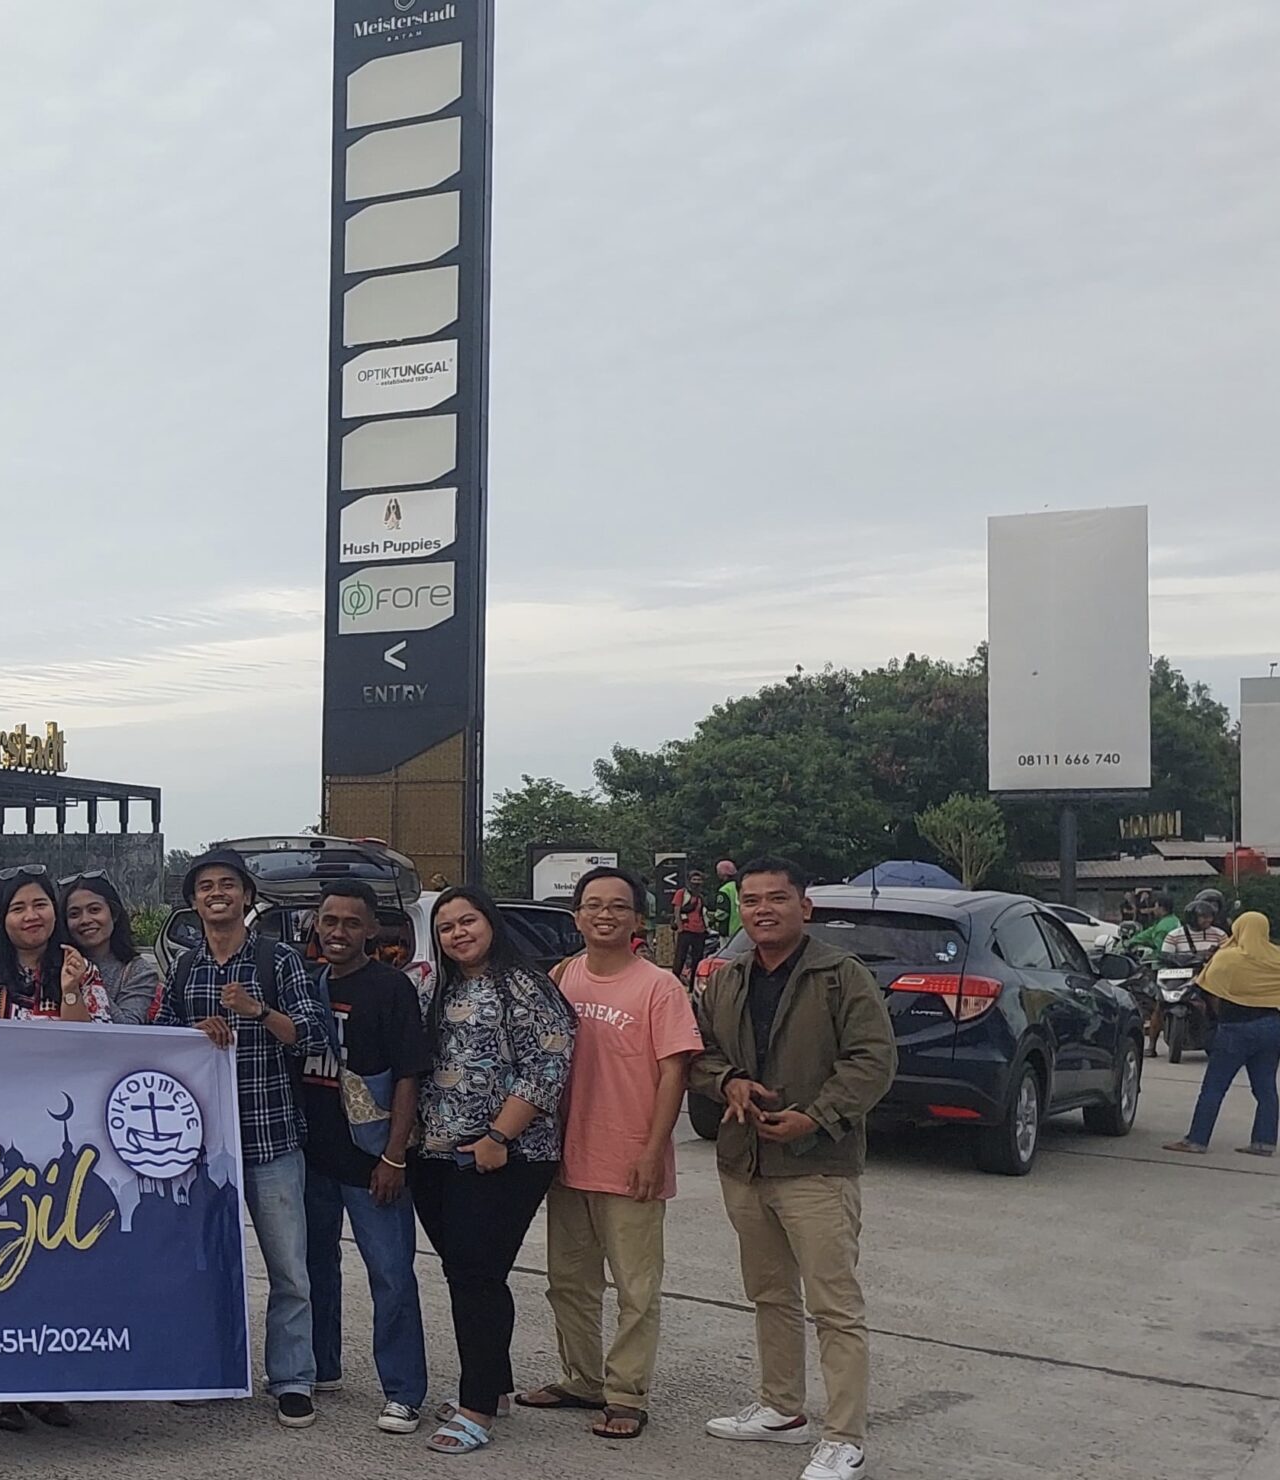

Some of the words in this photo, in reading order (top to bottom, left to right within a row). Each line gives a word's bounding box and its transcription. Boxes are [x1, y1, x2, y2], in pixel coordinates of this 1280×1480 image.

[353, 3, 456, 38] Meisterstadt
[342, 541, 379, 555] Hush
[382, 537, 441, 554] Puppies
[375, 584, 451, 610] fore
[362, 683, 428, 702] ENTRY
[1018, 754, 1059, 767] 08111
[1065, 753, 1090, 766] 666
[1095, 753, 1121, 765] 740
[574, 1002, 635, 1031] ENEMY
